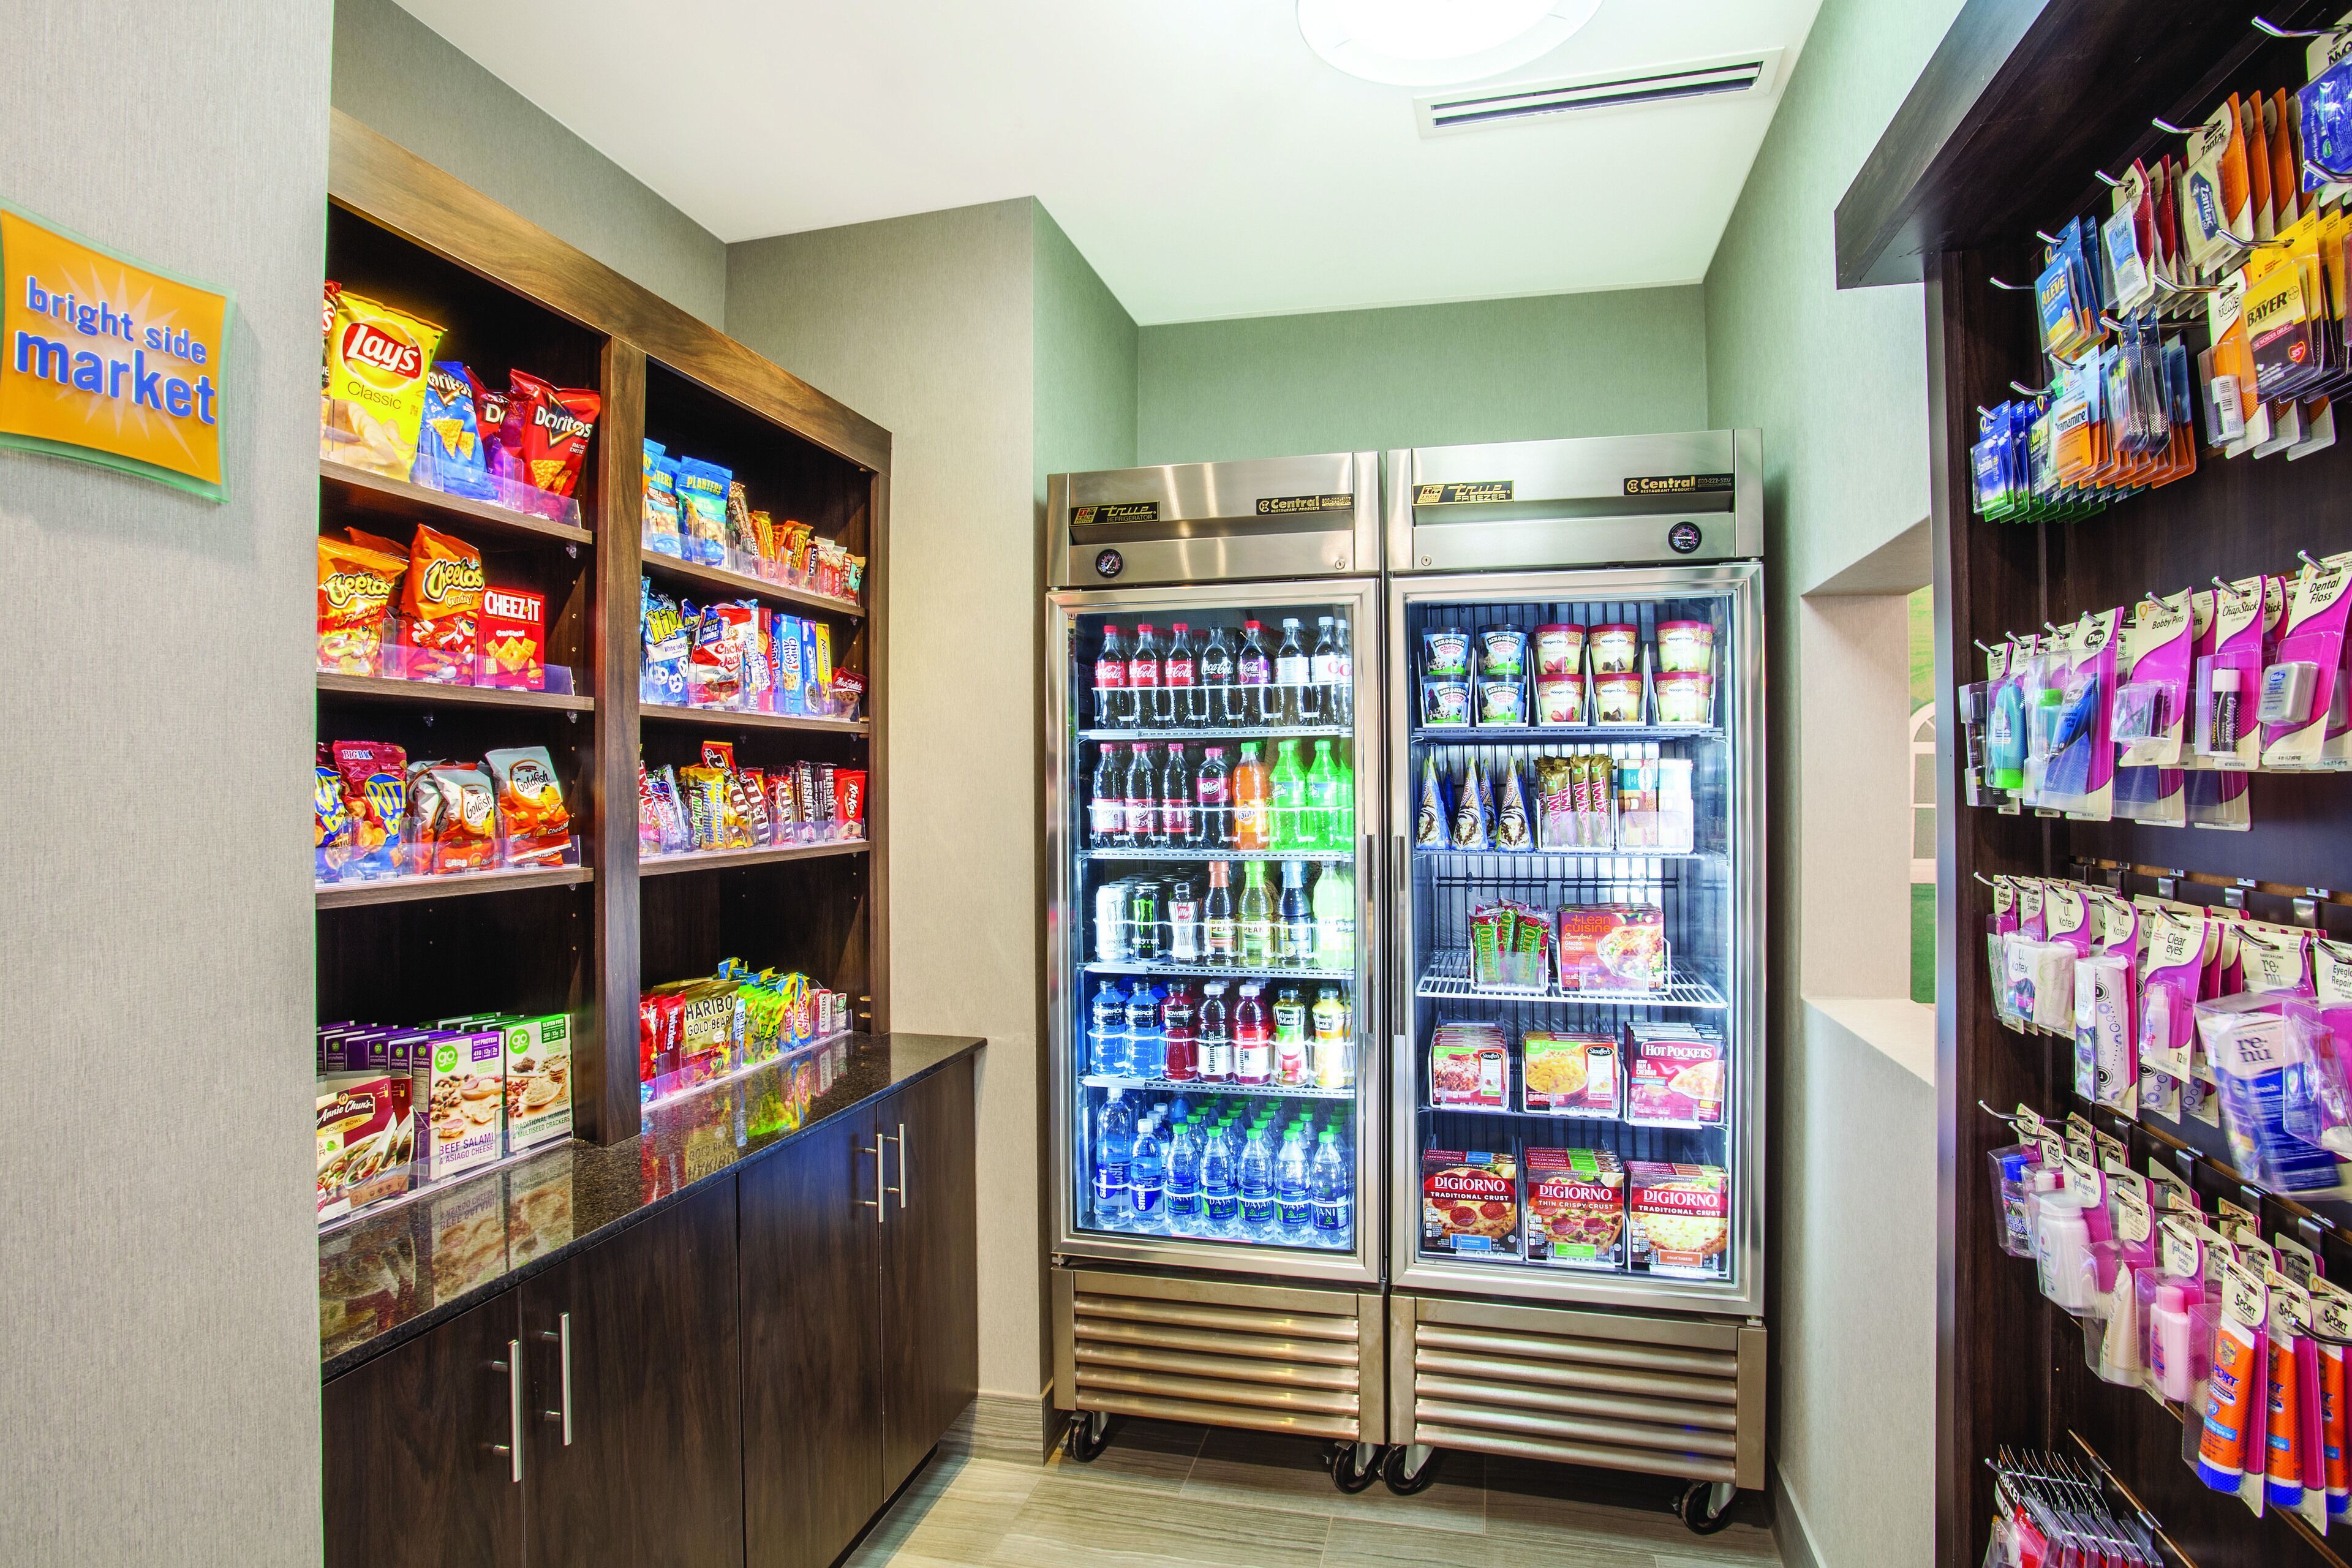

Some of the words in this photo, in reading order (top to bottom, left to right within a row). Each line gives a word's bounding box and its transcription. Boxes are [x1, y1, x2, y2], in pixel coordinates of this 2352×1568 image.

[2200, 184, 2214, 228] Zantac
[2041, 274, 2066, 307] ALEVE
[2246, 291, 2288, 328] BAYER
[26, 275, 134, 342] bright
[144, 325, 206, 365] side
[346, 325, 420, 372] Lay's
[14, 329, 216, 425] market
[428, 371, 472, 398] oritos
[347, 381, 402, 410] Classic
[535, 405, 593, 438] Doritos
[687, 475, 723, 495] PLANTERS
[1640, 475, 1695, 489] Central
[1271, 496, 1320, 509] Central
[423, 557, 484, 601] Cheetos
[2309, 576, 2341, 594] Dental
[445, 592, 473, 608] Crunchy
[2310, 590, 2332, 605] Floss
[2222, 598, 2258, 617] ChapStick
[2152, 618, 2171, 630] Bobby
[2171, 614, 2184, 625] Pins
[2088, 633, 2104, 644] Dep
[1201, 660, 1234, 675] Coca-Cola
[516, 771, 549, 793] Goldfish
[802, 768, 814, 823] HERSHEY'S
[466, 792, 492, 820] Goldfish
[2027, 896, 2039, 905] Cotton
[2027, 903, 2039, 912] Swabs
[1178, 907, 1189, 918] illy
[2167, 932, 2187, 946] Clear
[2166, 943, 2184, 956] eyes
[2331, 975, 2352, 988] Repair
[685, 994, 734, 1022] HARIBO
[511, 1033, 528, 1049] go
[437, 1050, 455, 1067] go
[1645, 1044, 1666, 1057] HOT
[1667, 1046, 1713, 1059] POCKETS
[317, 1104, 344, 1125] Annie
[345, 1099, 373, 1113] Chun's
[325, 1123, 343, 1133] SOUP
[345, 1117, 363, 1127] BOWL
[513, 1116, 546, 1131] TRADITIONAL
[518, 1126, 545, 1138] MULTISEED
[546, 1117, 570, 1129] CRACKERS
[439, 1142, 461, 1155] BEEF
[463, 1132, 494, 1149] SALAMI
[445, 1150, 470, 1164] ASIAGO
[471, 1143, 494, 1156] CHEESE
[2073, 1175, 2097, 1195] Johnson's
[1430, 1191, 1482, 1200] TRADITIONAL
[1638, 1205, 1694, 1215] TRADITIONAL
[2171, 1240, 2195, 1264] Johnson's
[2177, 1256, 2189, 1268] baby
[2177, 1265, 2190, 1275] lotion
[2234, 1292, 2256, 1317] SPORT
[2323, 1310, 2348, 1333] SPORT
[2214, 1363, 2239, 1388] PORT
